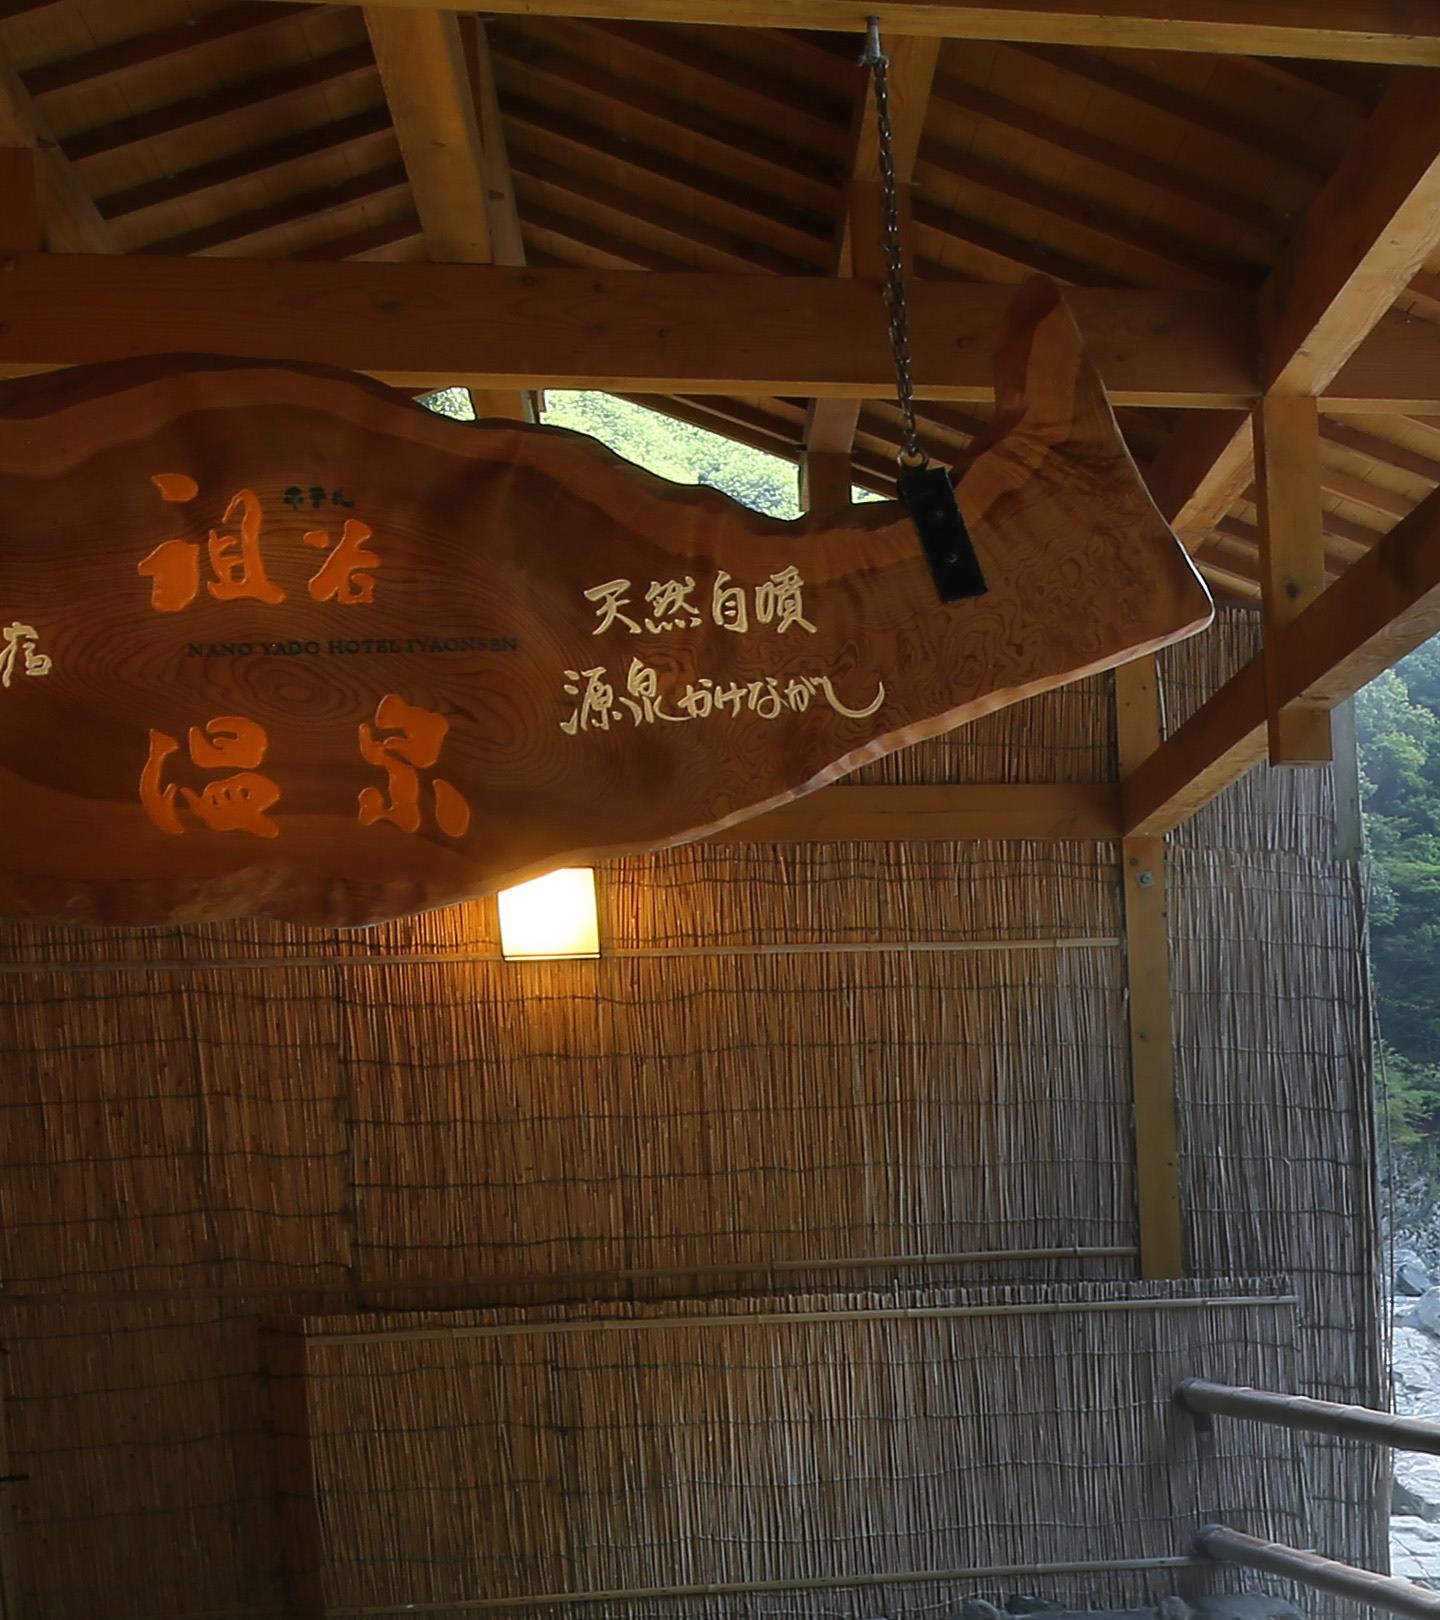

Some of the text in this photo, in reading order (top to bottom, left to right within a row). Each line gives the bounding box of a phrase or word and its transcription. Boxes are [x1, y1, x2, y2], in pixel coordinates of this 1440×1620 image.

[137, 472, 383, 614] 祖谷
[583, 564, 818, 636] 天然自噴
[261, 640, 321, 656] YADO
[328, 638, 401, 655] HOTEL
[560, 656, 886, 736] 源泉かけながし
[139, 694, 471, 839] 温泉
